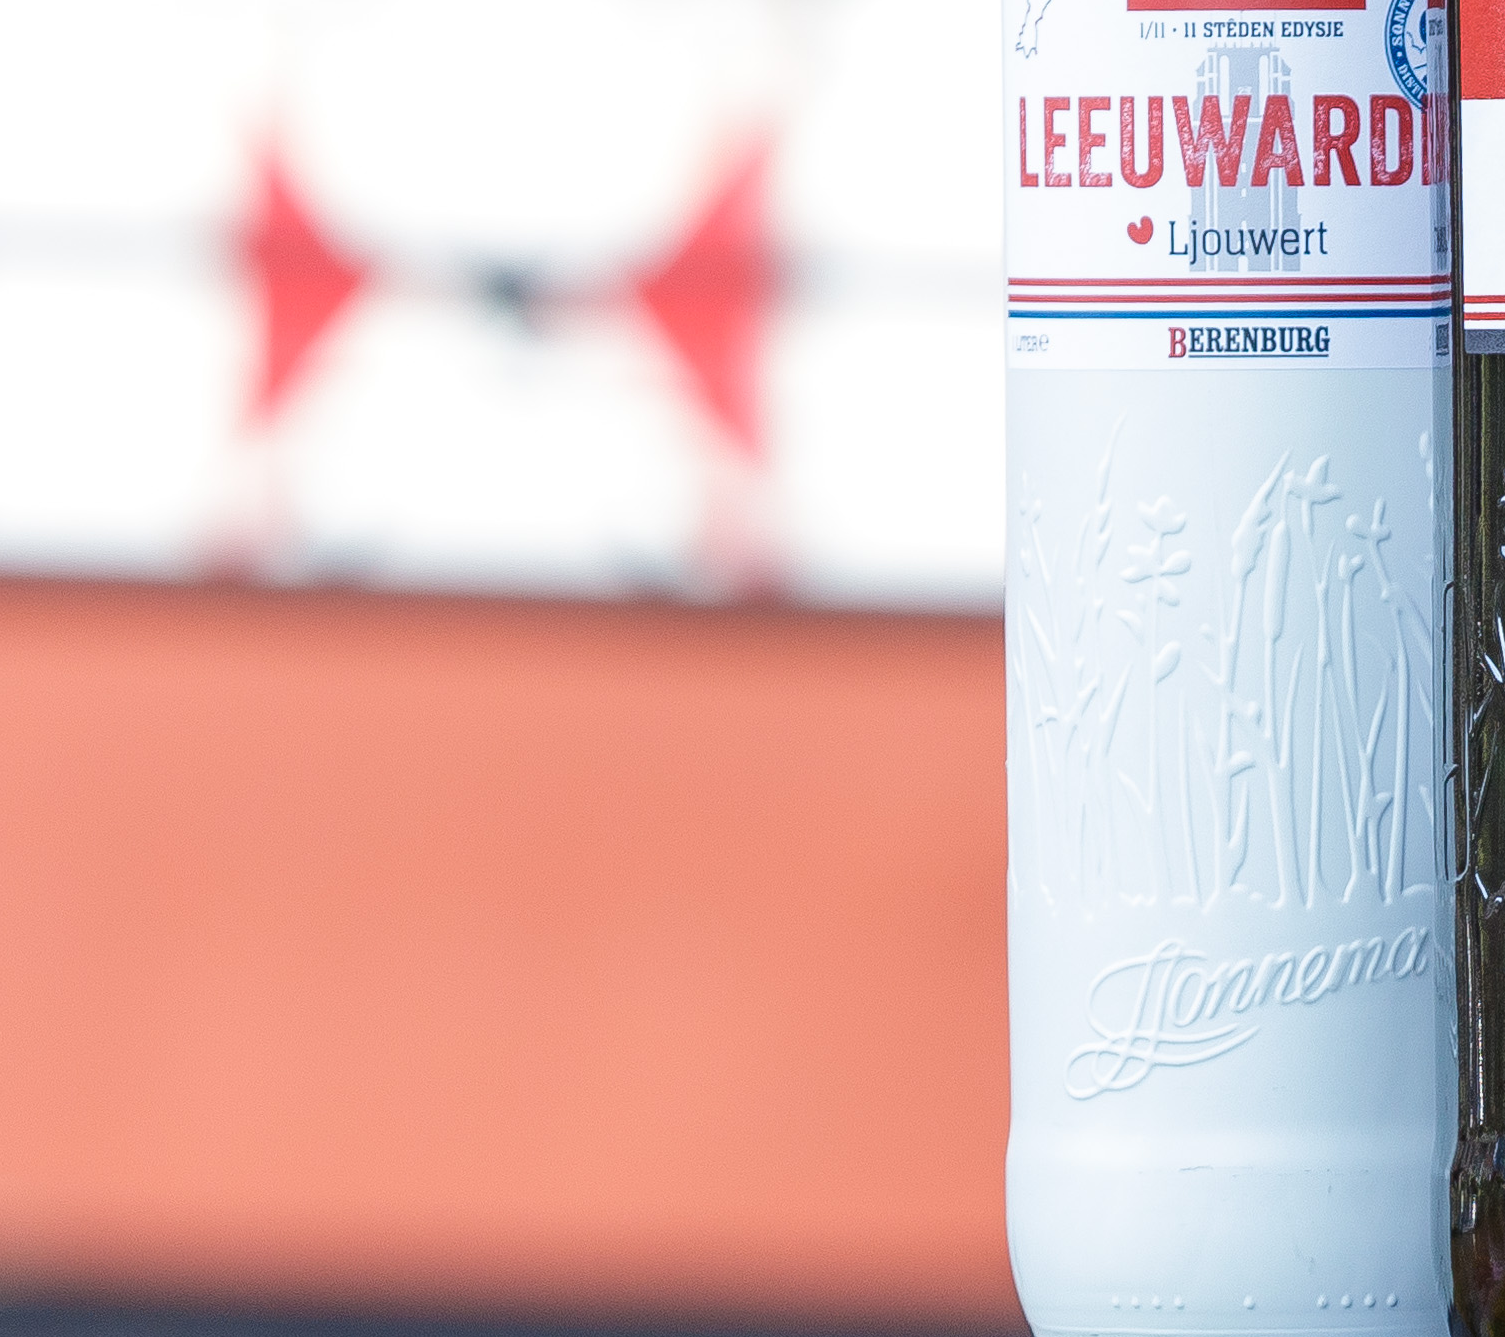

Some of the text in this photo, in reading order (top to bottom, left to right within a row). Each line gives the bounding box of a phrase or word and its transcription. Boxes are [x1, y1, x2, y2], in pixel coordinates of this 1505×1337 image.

[1203, 17, 1276, 39] STÊDEN
[1280, 20, 1345, 39] EDYSJE
[1168, 220, 1329, 264] Ljouwert
[1167, 325, 1330, 360] BERENBURG
[1063, 925, 1429, 1101] Sonnema
